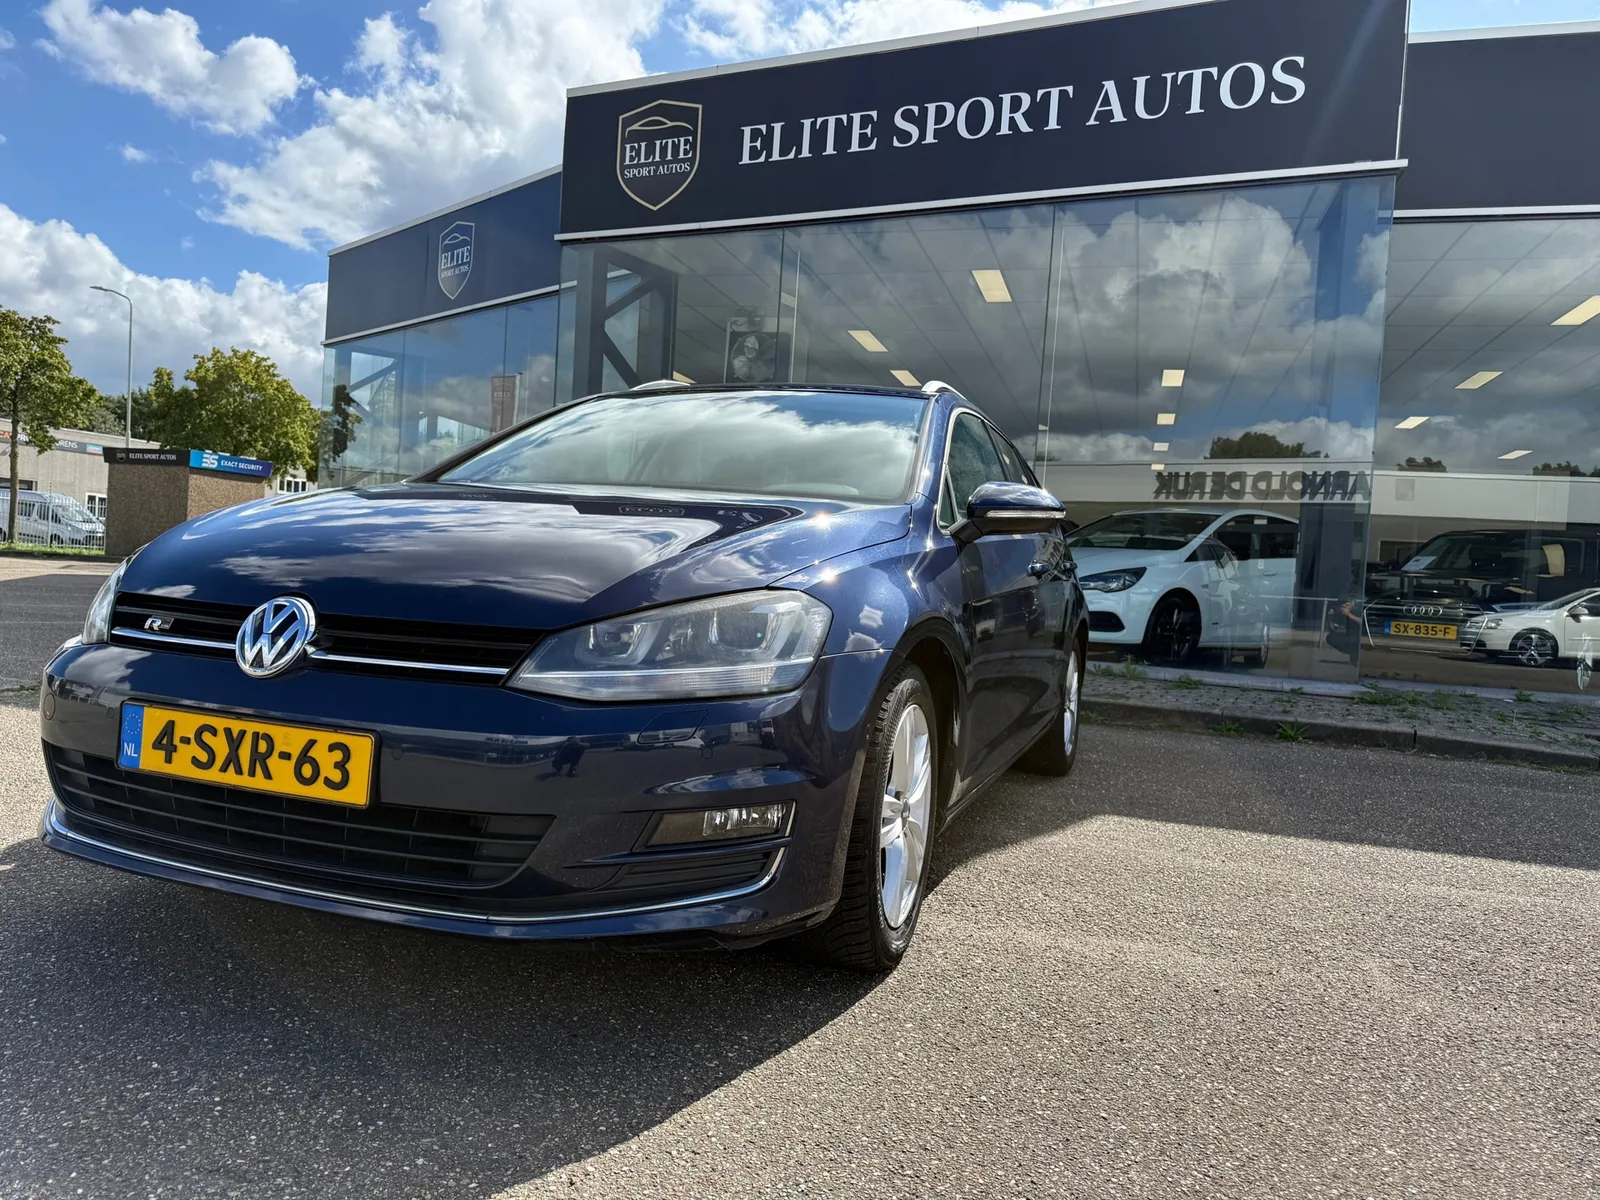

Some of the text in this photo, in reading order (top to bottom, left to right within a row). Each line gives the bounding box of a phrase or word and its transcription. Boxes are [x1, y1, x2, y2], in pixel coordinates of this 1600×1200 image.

[738, 56, 1307, 165] ELITE SPORT AUTOS
[624, 136, 693, 165] ELITE
[624, 161, 691, 179] SPORT AUTOS
[441, 245, 471, 269] ELITE
[440, 264, 469, 279] SPORT AUTOS
[220, 460, 237, 468] EXACT
[238, 462, 263, 471] SECURITY
[1393, 623, 1451, 637] SX-835-F
[123, 719, 351, 791] NL 4-SXR-63
